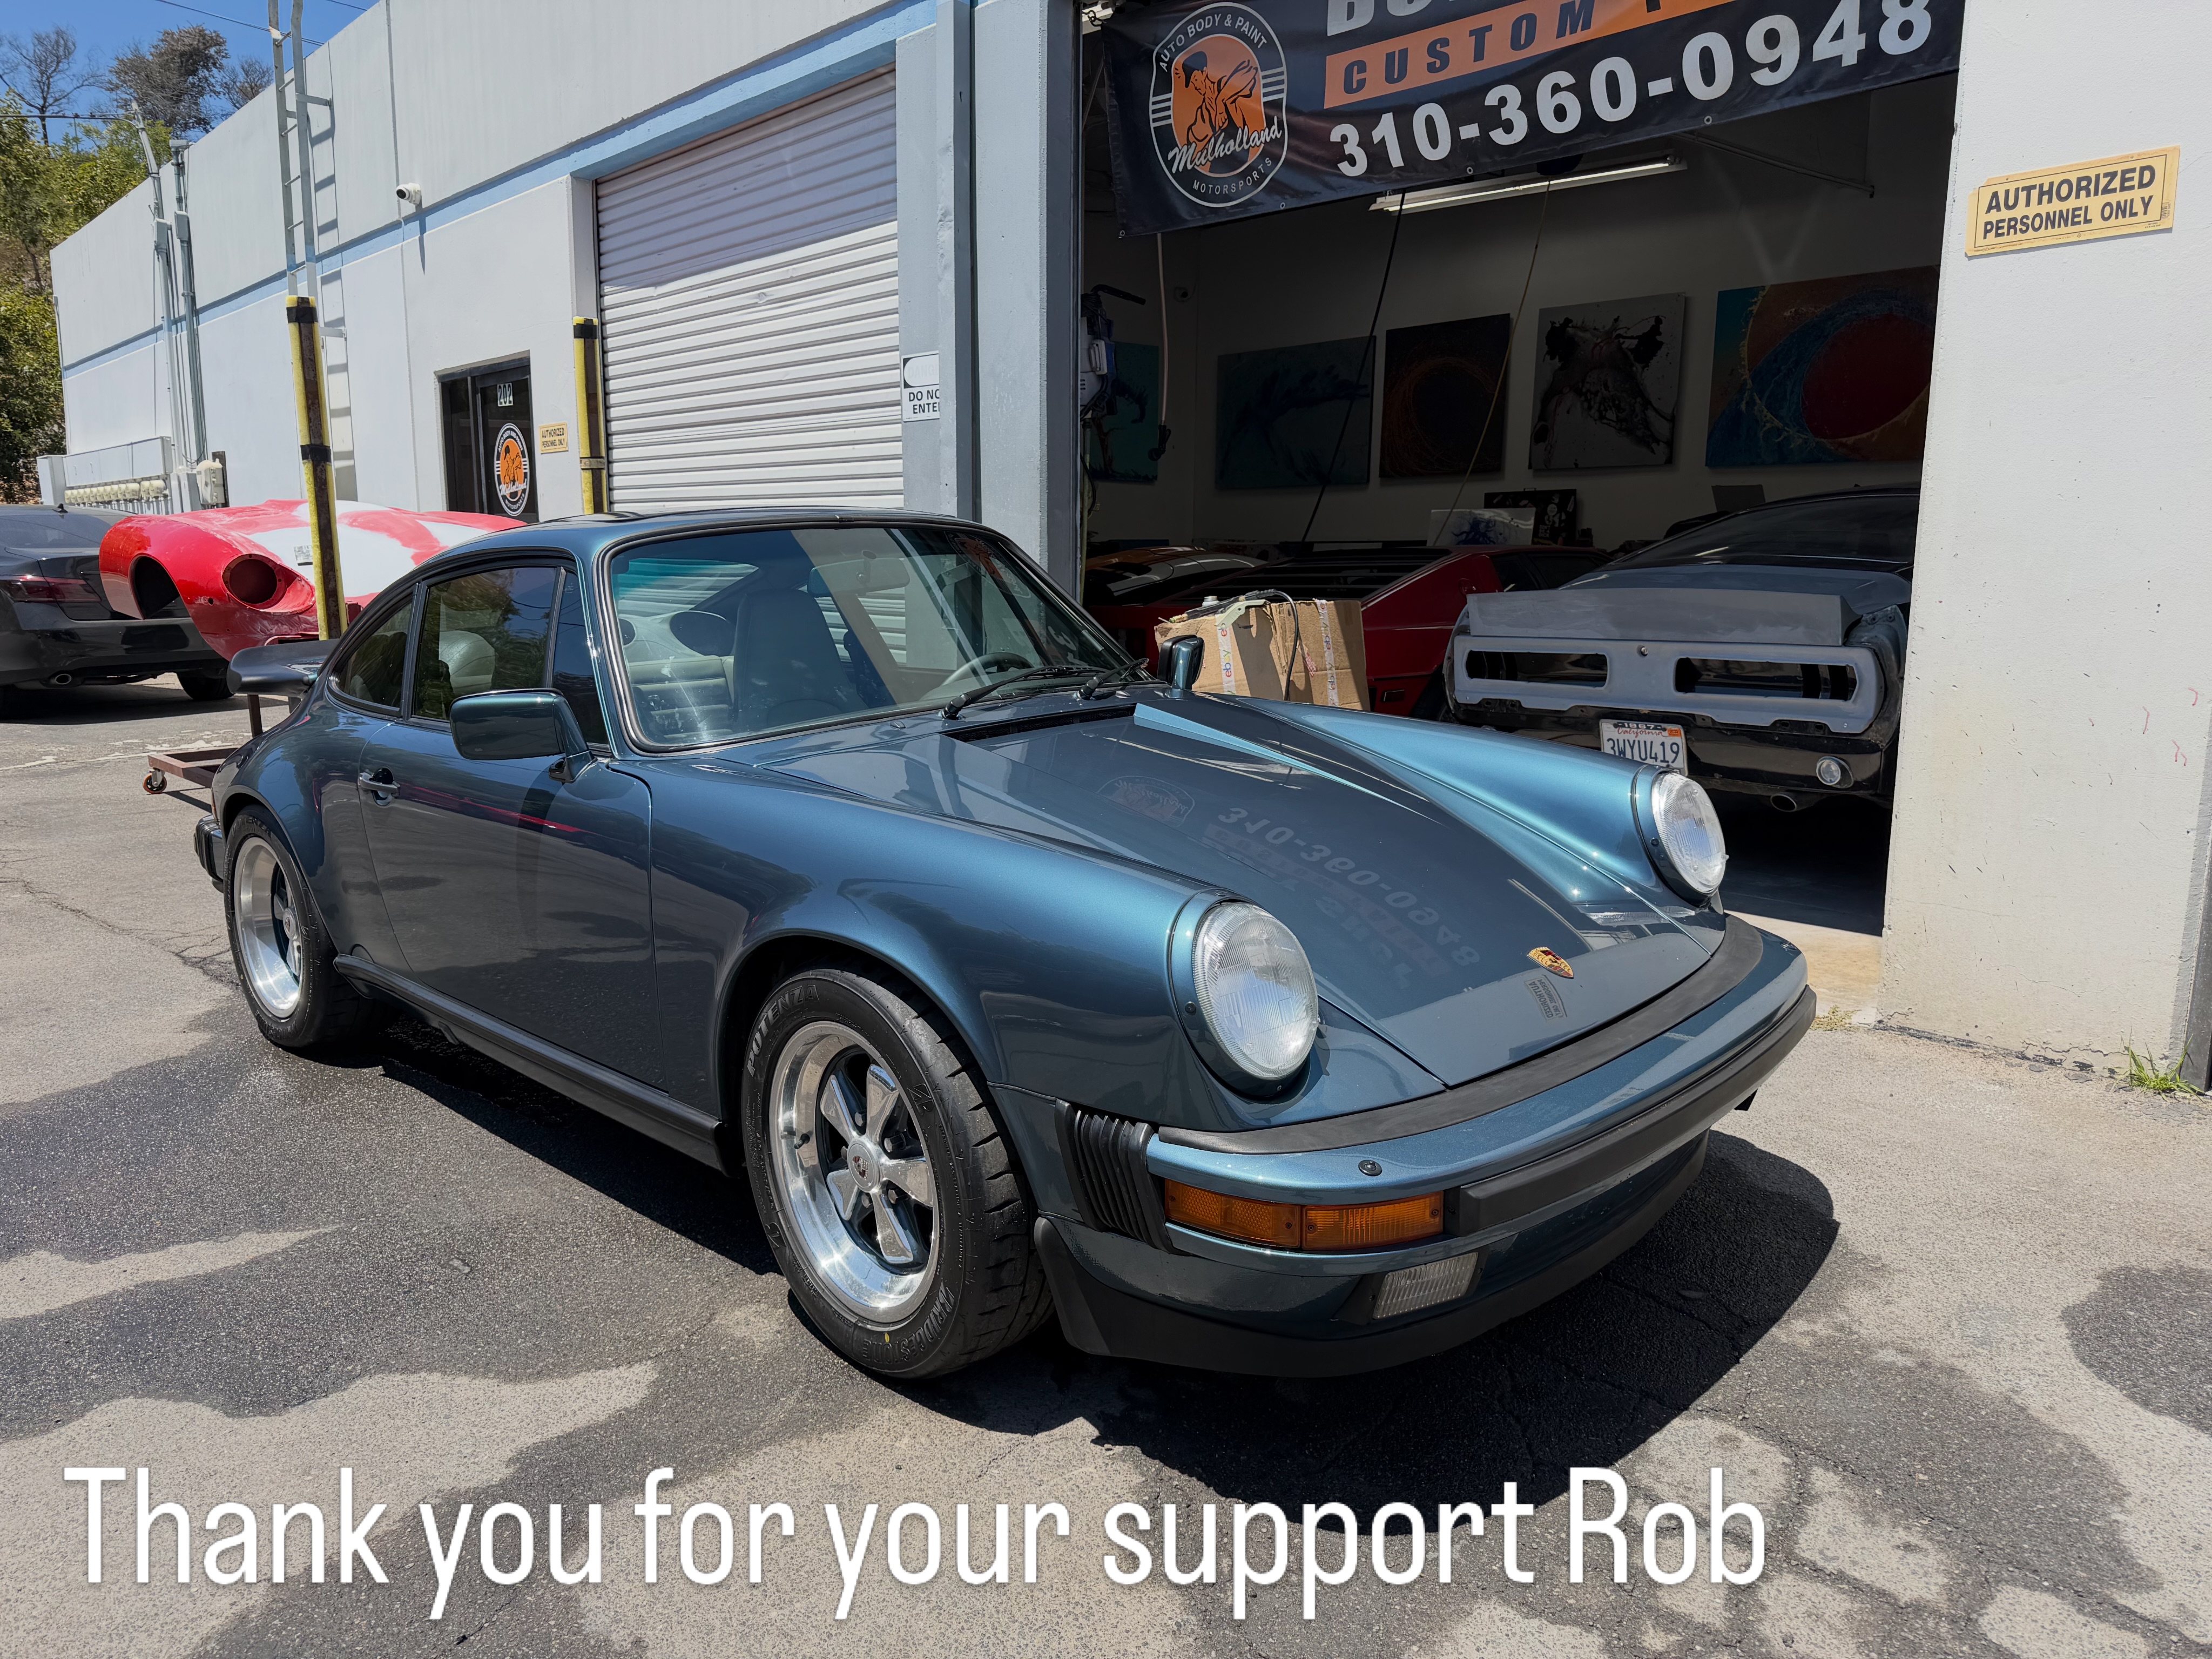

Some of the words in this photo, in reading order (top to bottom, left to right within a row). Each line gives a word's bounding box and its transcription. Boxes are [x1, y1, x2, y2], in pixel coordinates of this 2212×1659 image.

[1159, 36, 1185, 72] AUTO
[1187, 14, 1222, 38] BODY
[1224, 14, 1232, 26] &
[1235, 16, 1267, 49] PAINT
[1343, 0, 1595, 94] CUSTOM
[1330, 0, 1932, 177] 310-360-0948
[1168, 116, 1282, 174] Mulholland
[1192, 157, 1272, 194] MOTORSPORTS
[1985, 165, 2156, 214] AUTHORIZED
[1982, 205, 2093, 240] PERSONNEL
[2100, 195, 2154, 221] ONLY
[498, 384, 512, 405] 202
[909, 391, 923, 402] DO
[927, 389, 939, 400] NO
[913, 402, 940, 414] ENTE
[542, 428, 564, 438] AUTHORIZED
[1607, 738, 1680, 763] 3WYU419
[1617, 727, 1668, 738] California
[747, 985, 820, 1077] POTENZA
